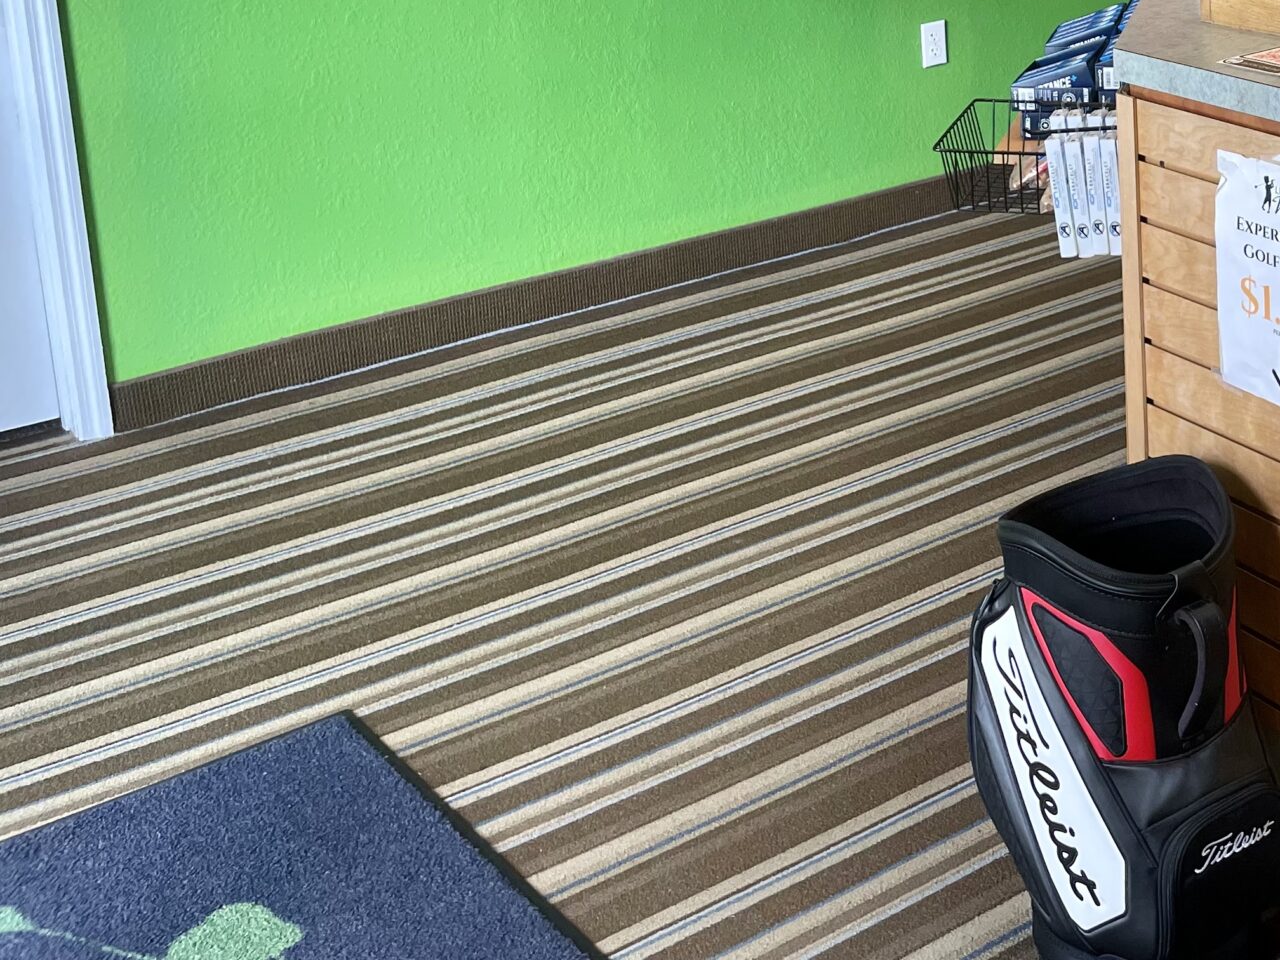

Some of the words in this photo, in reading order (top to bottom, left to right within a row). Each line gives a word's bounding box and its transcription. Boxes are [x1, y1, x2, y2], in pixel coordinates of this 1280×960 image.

[1243, 243, 1280, 268] GOLF
[993, 634, 1101, 913] Titleist
[1194, 819, 1276, 875] Titleist
